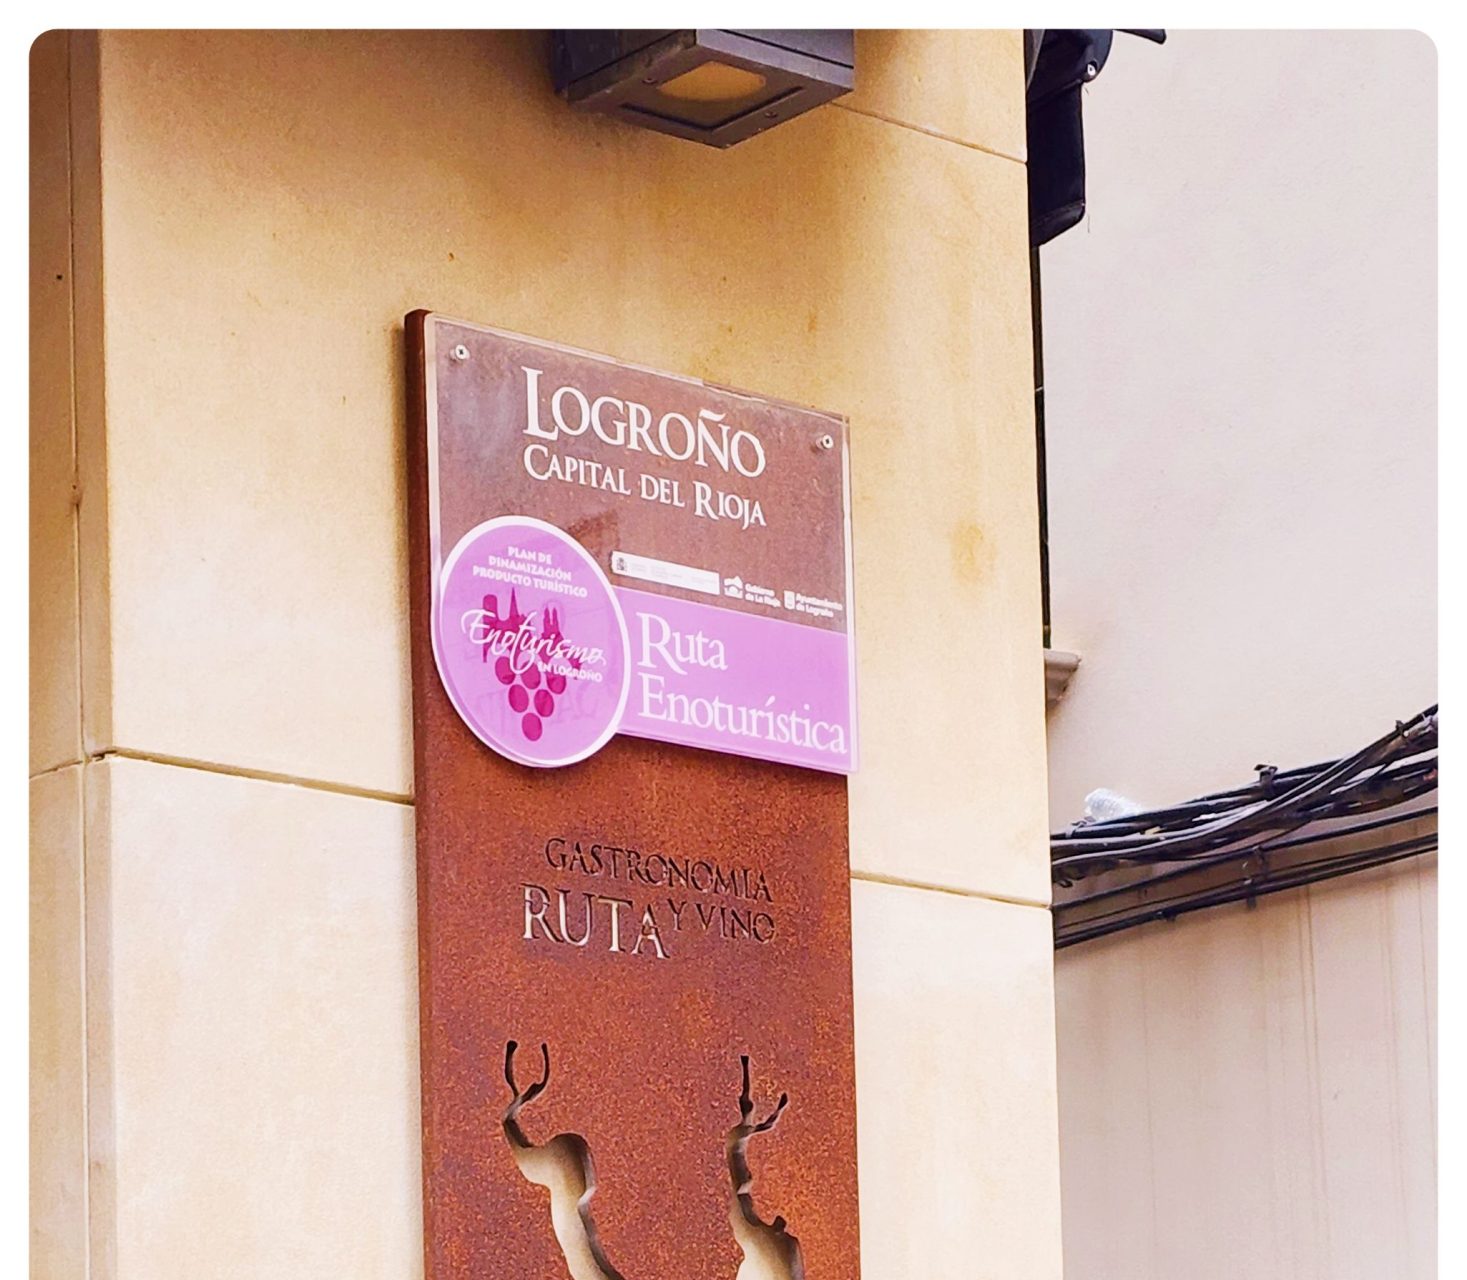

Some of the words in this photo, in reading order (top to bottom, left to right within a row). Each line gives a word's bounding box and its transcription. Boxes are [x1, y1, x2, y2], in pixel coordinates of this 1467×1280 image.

[522, 366, 766, 478] LOGROÑO
[524, 444, 631, 496] CAPITAL
[640, 475, 685, 508] DEL
[694, 481, 767, 530] RIOJA
[472, 565, 532, 587] PRODUCTO
[533, 577, 588, 598] TURÍSTICO
[488, 555, 572, 582] DINAMIZACIÓN
[508, 546, 537, 561] PLAN
[538, 552, 552, 564] DE
[460, 609, 606, 675] Enoturismo
[537, 660, 552, 673] EN
[553, 663, 603, 684] LOGROÑO
[636, 611, 728, 676] Ruta
[636, 671, 848, 755] Enoturística
[545, 837, 775, 903] GASTRONOMIA
[520, 883, 671, 960] RUTA
[667, 898, 688, 932] Y
[694, 903, 776, 945] VINO
